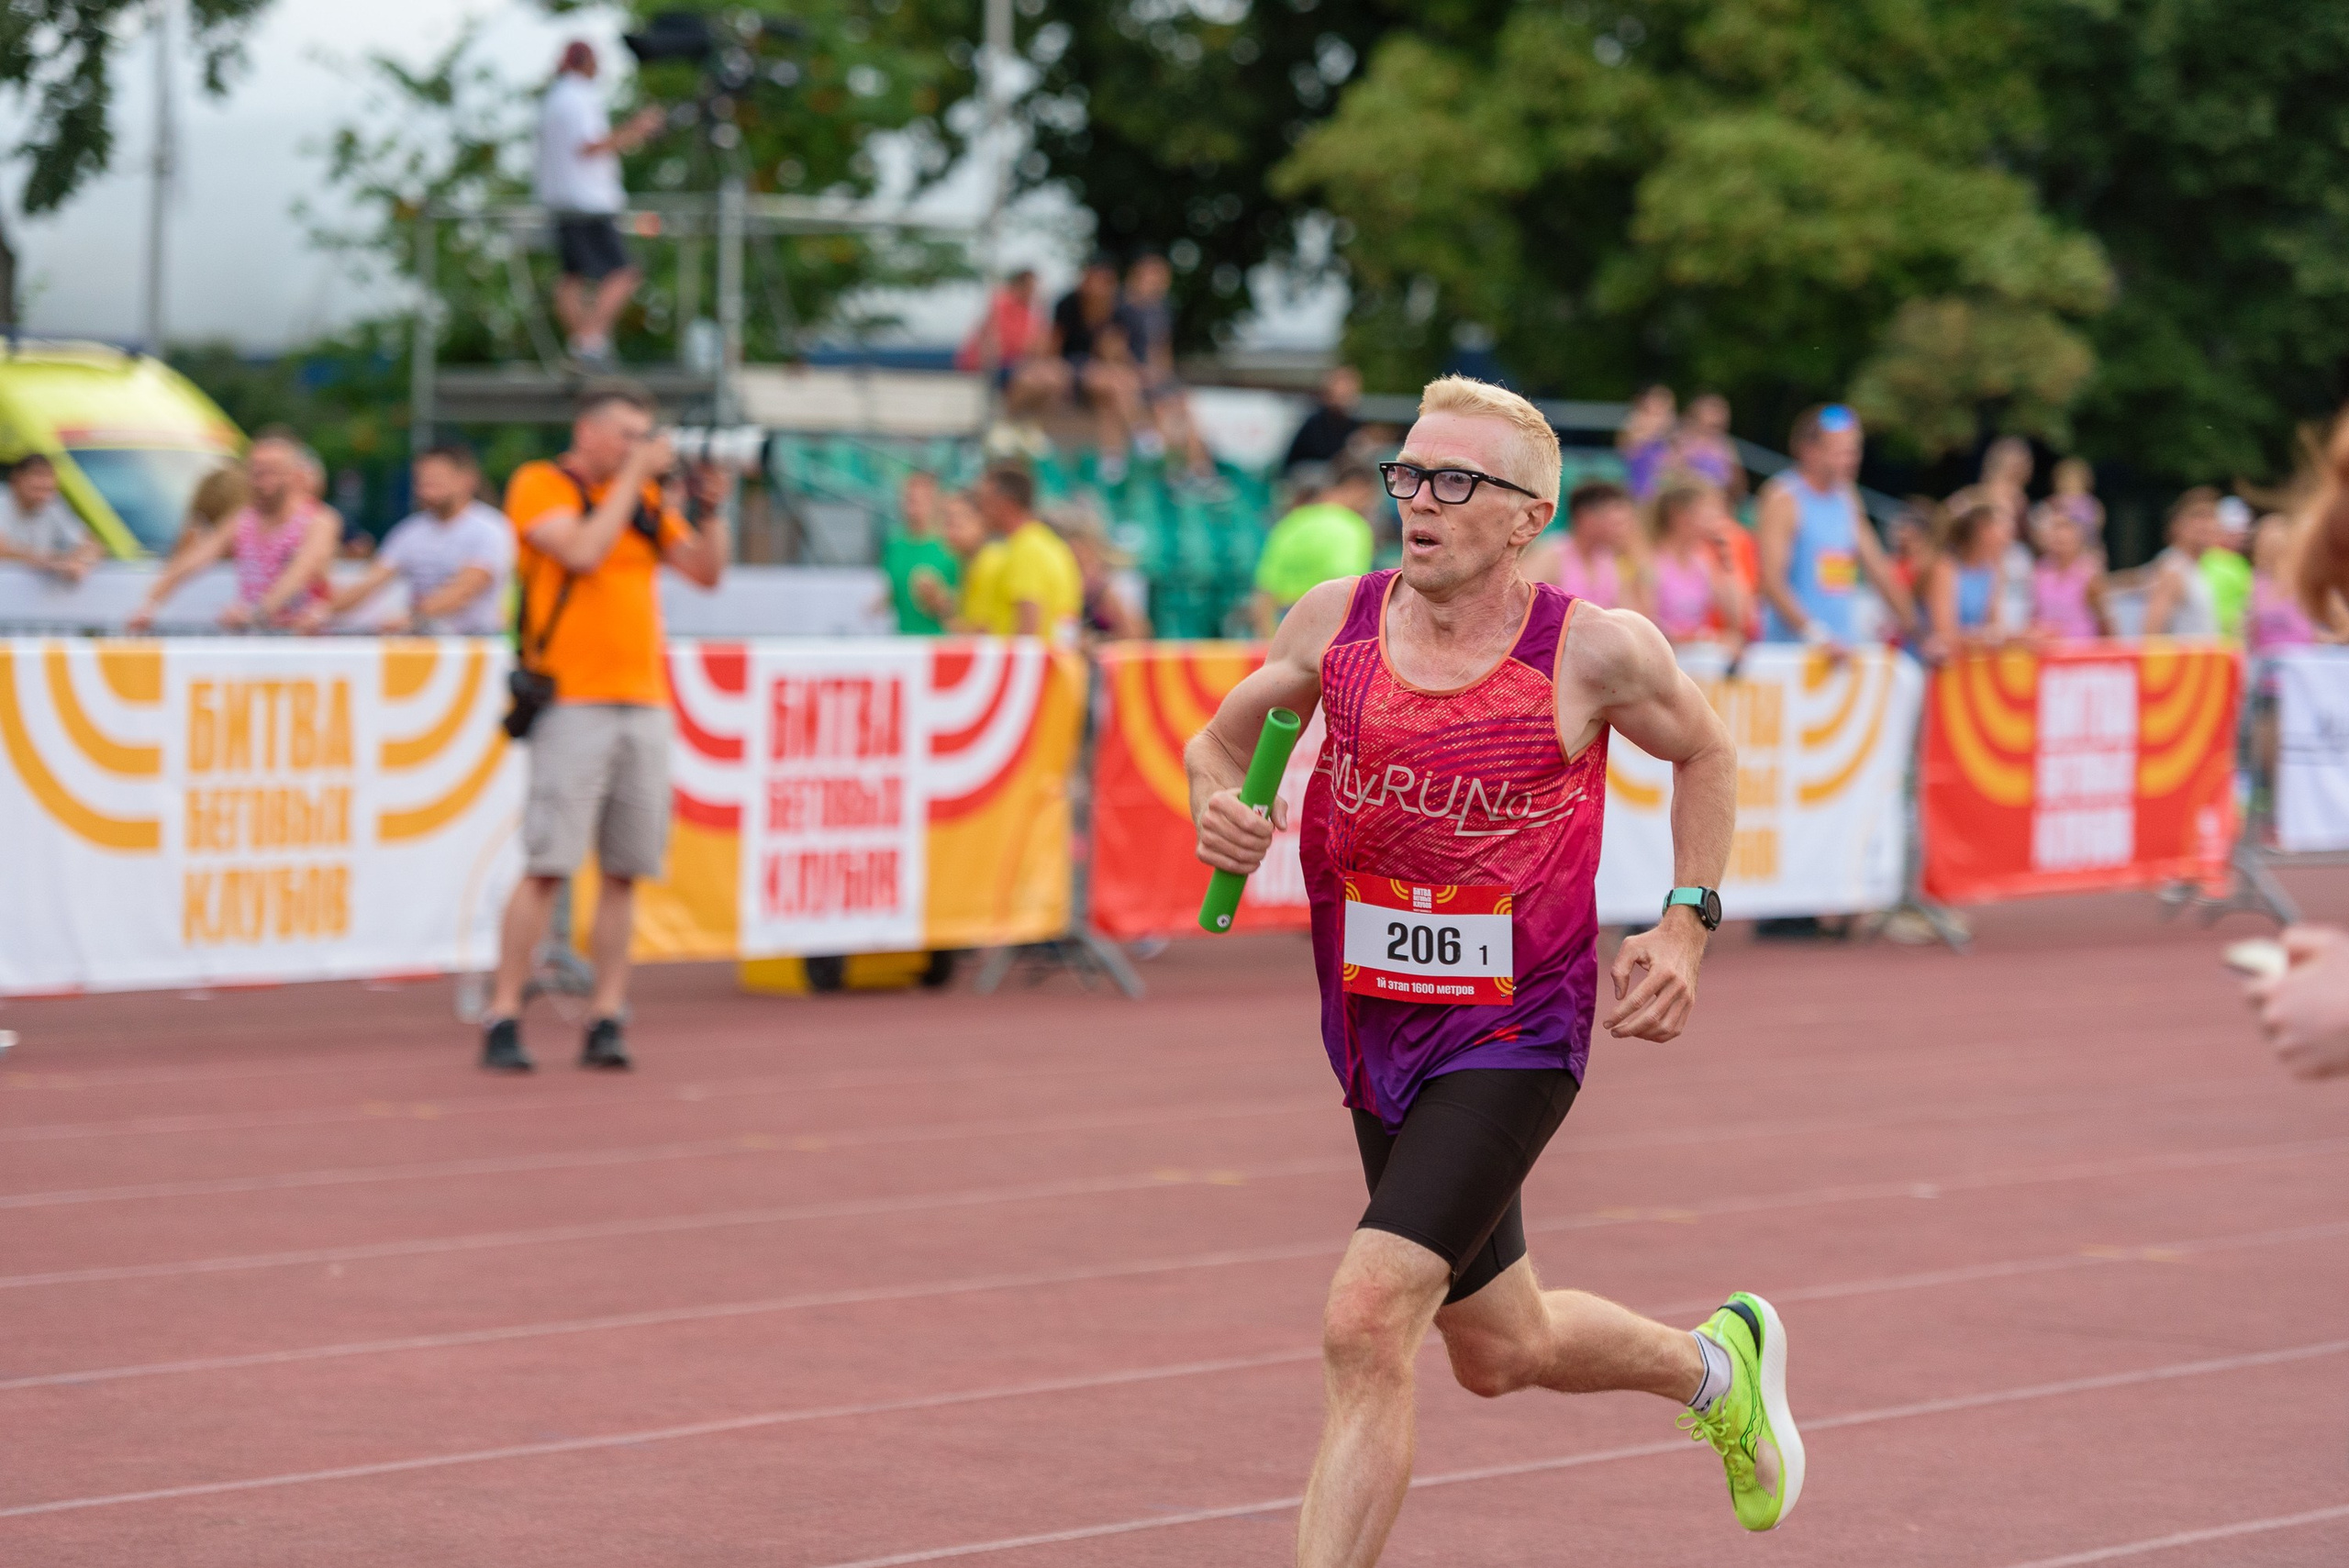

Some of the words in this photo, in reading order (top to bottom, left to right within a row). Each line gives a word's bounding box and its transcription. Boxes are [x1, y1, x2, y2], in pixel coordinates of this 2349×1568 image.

[188, 679, 354, 773] БИТВА
[772, 676, 904, 761] БИТВА
[186, 787, 354, 853] БЕГОВЫХ
[182, 865, 352, 947] КЛУБОВ
[1387, 921, 1462, 965] 206
[1478, 944, 1488, 966] 1
[1376, 976, 1386, 989] 1й
[1387, 980, 1409, 992] этап
[1410, 982, 1435, 995] 1600
[1436, 984, 1475, 996] метров
